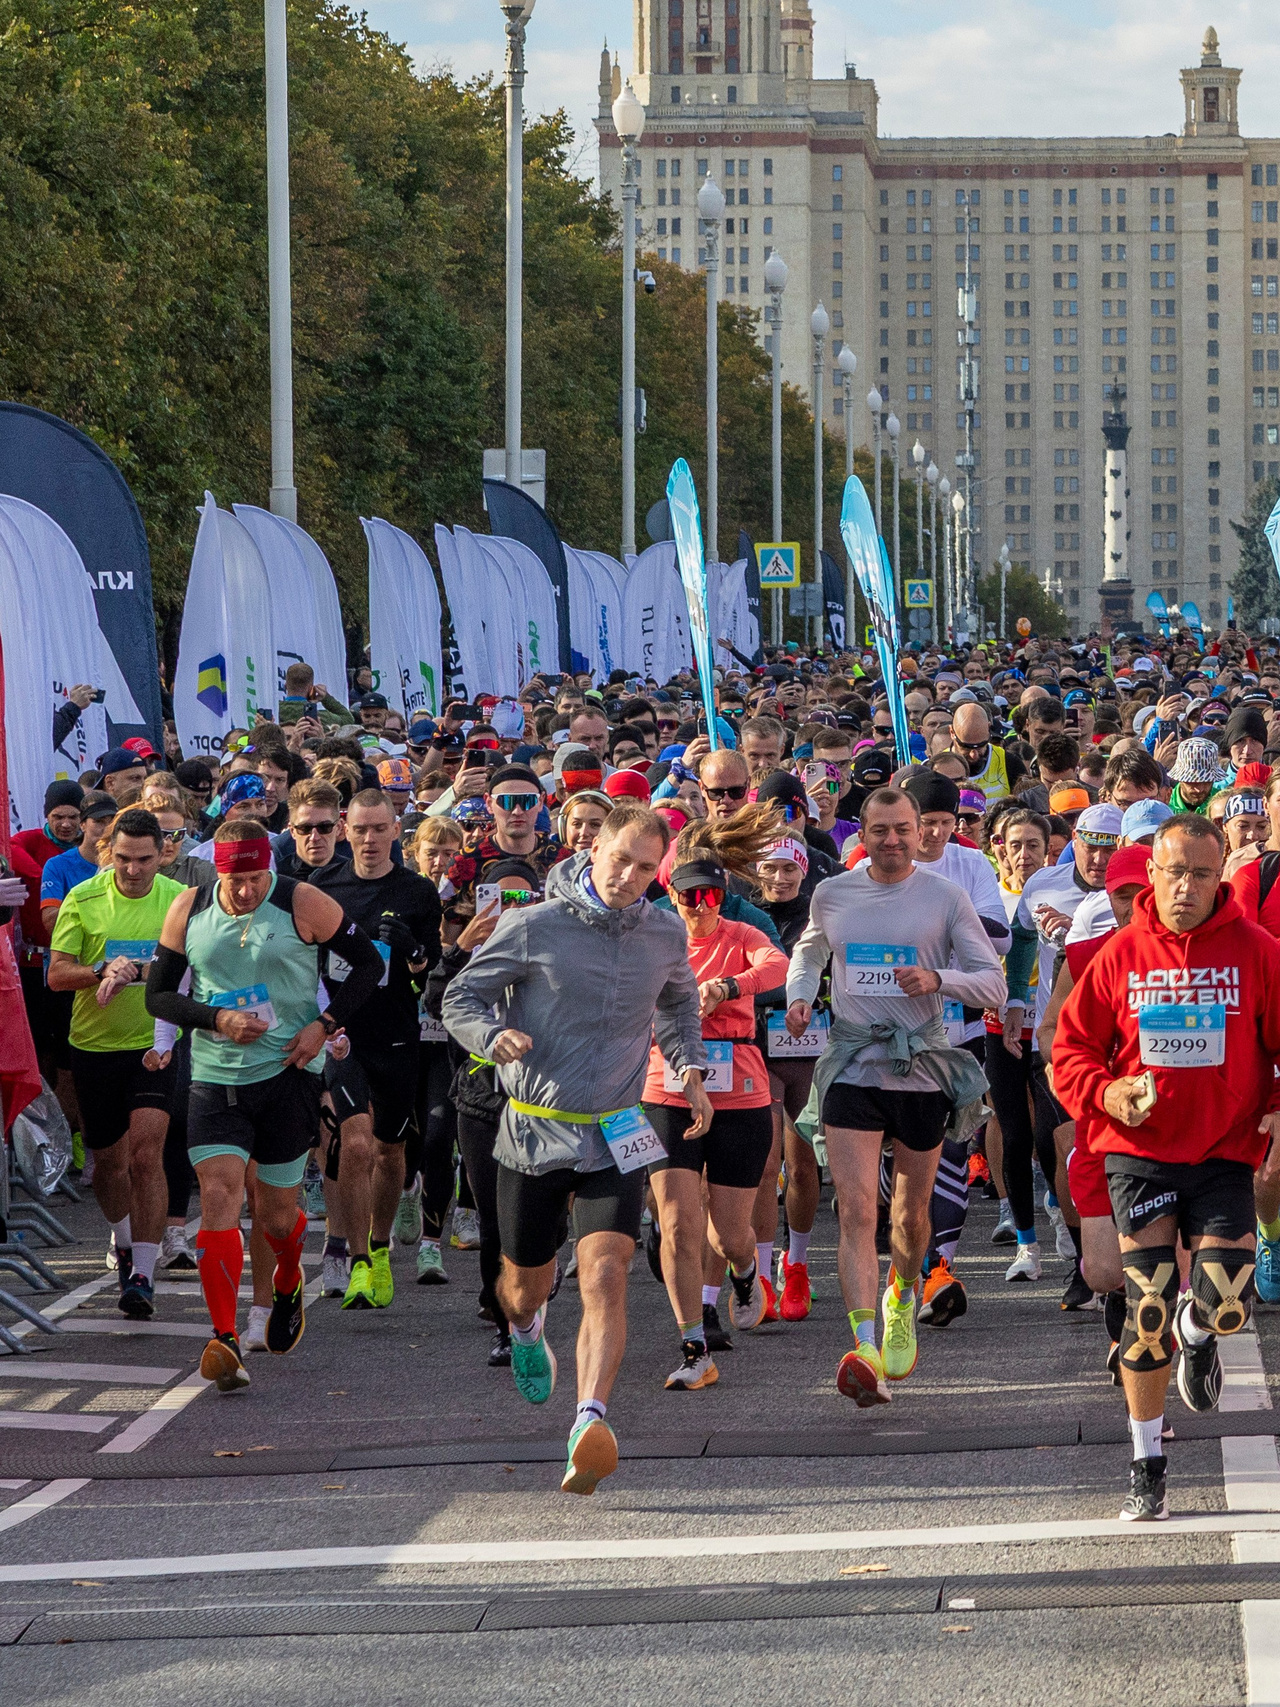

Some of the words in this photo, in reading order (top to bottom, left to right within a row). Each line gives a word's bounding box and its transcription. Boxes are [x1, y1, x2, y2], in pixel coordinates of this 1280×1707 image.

[1128, 987, 1239, 1011] WIDZEW
[1148, 1038, 1208, 1054] 22999
[1129, 1191, 1178, 1219] ISPORT
